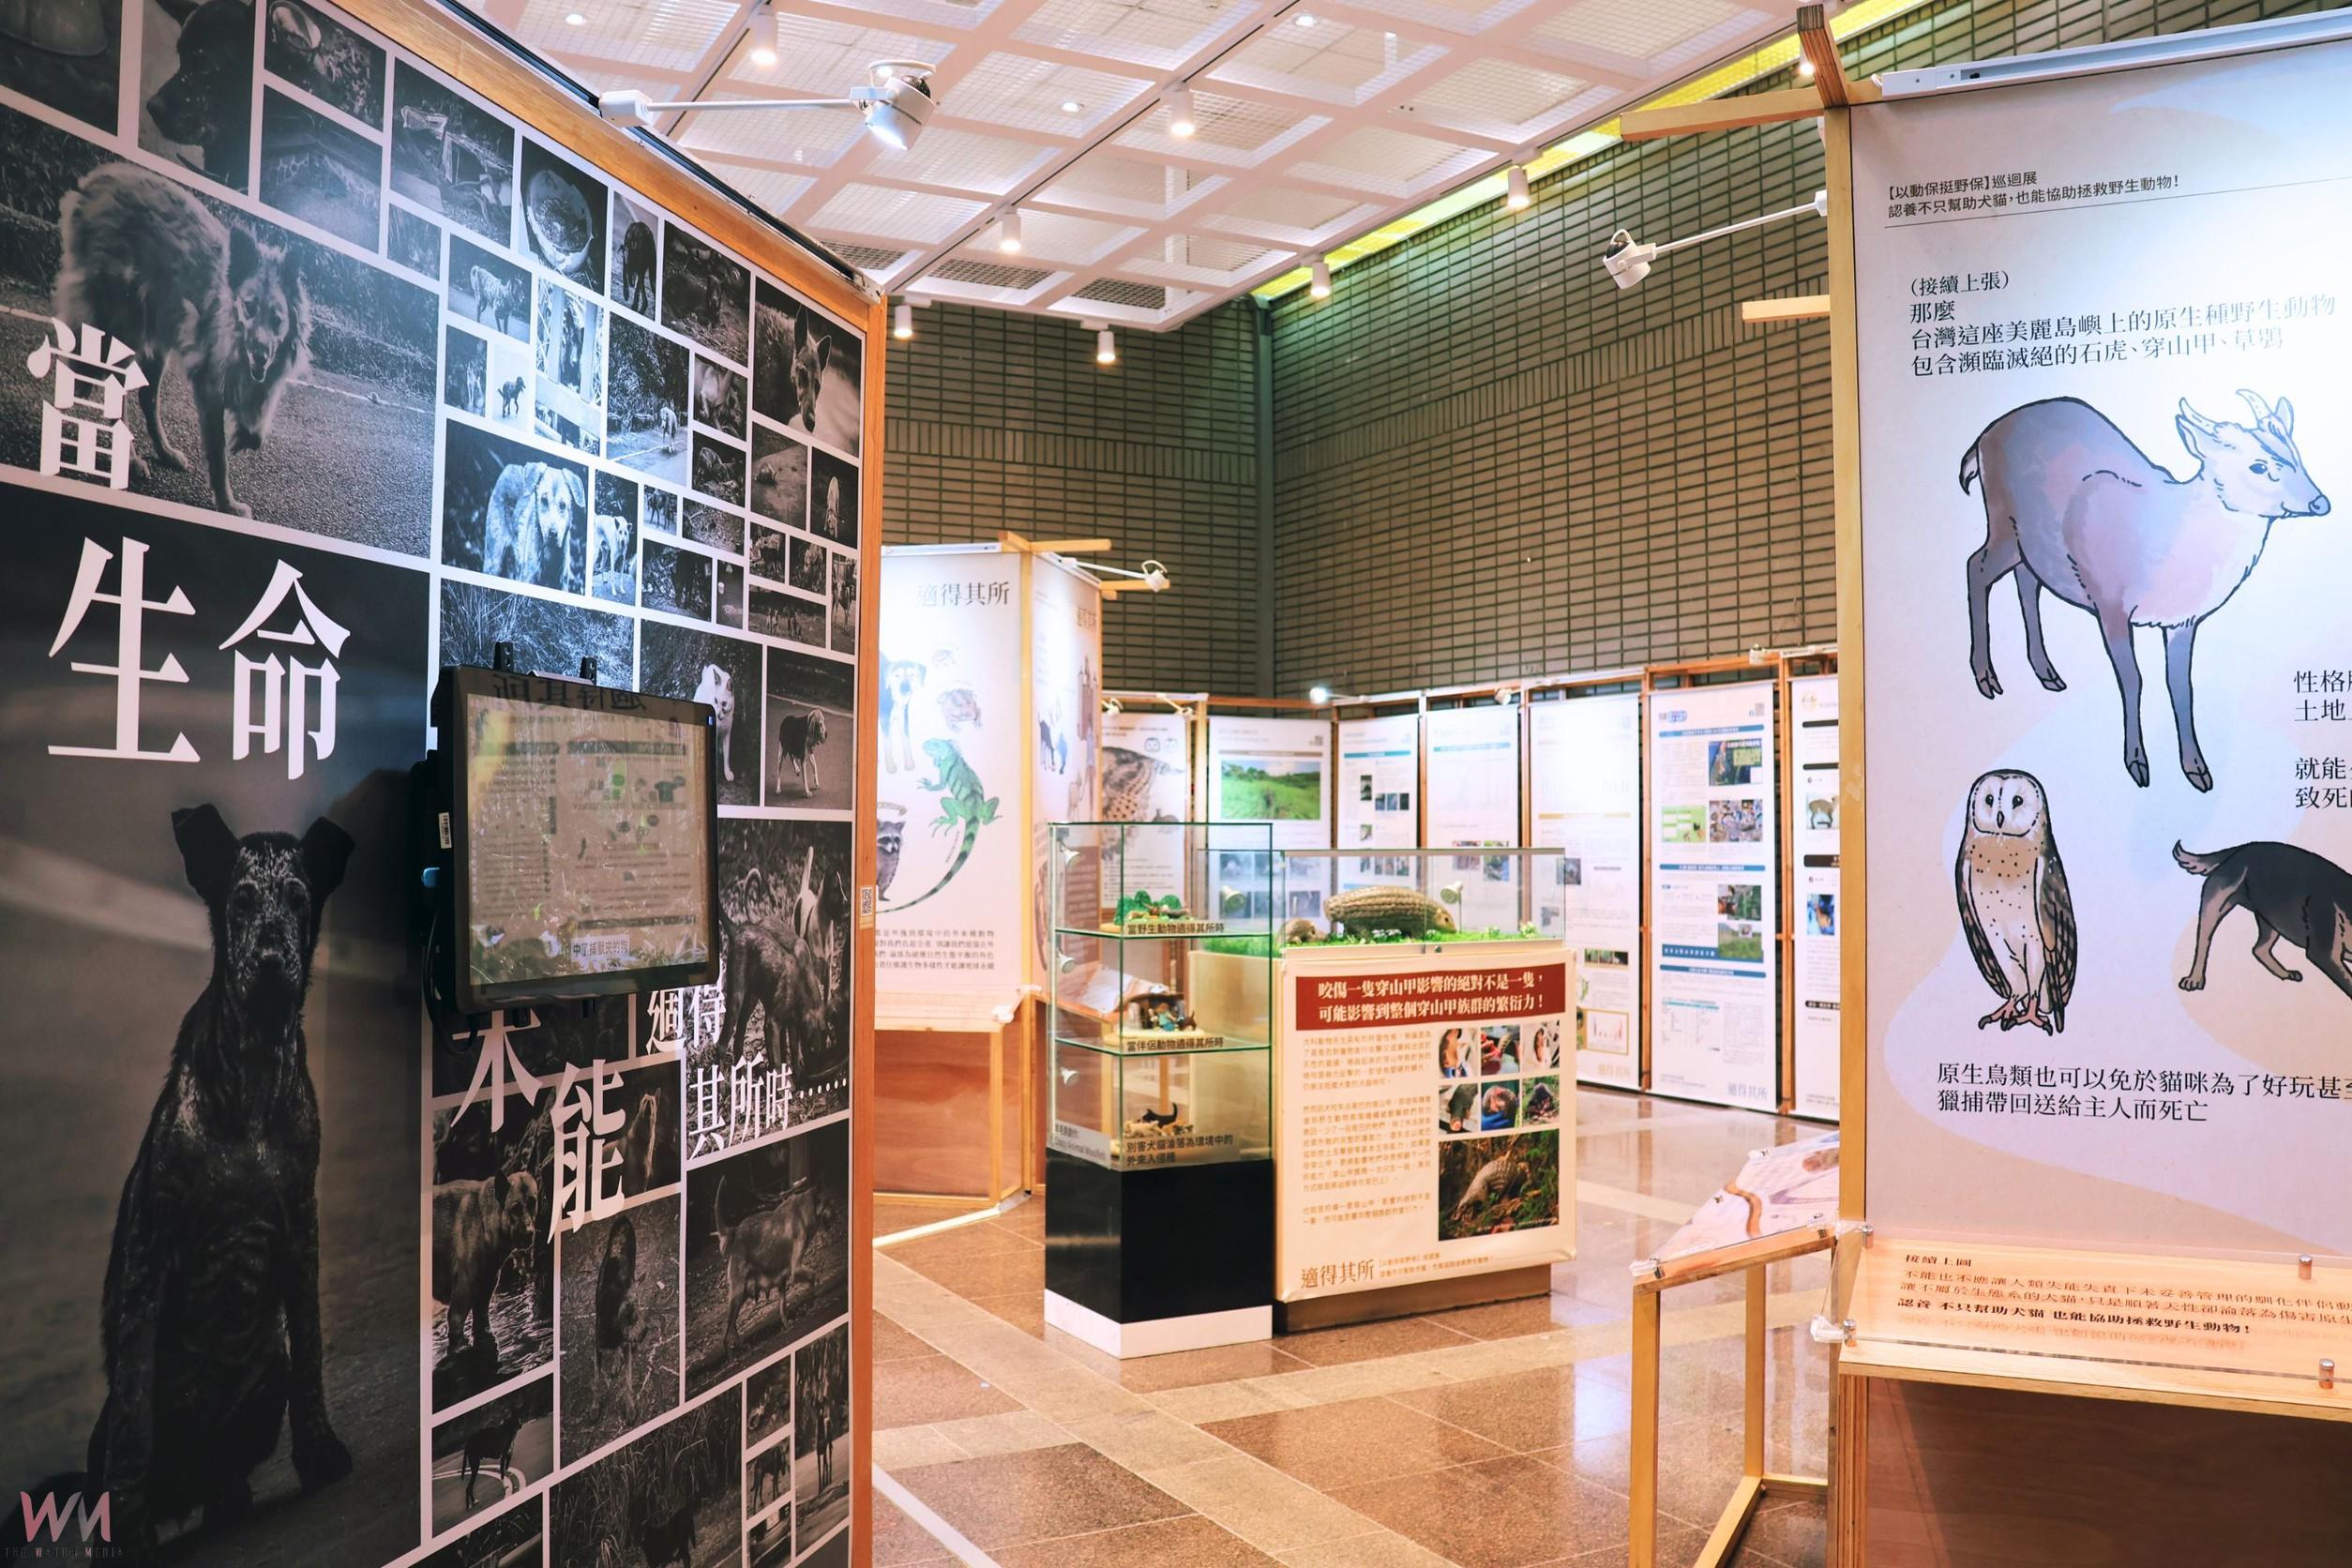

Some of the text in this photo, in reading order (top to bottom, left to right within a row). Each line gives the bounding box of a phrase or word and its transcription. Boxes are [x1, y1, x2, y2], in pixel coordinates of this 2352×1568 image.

[1888, 171, 2038, 202] 【以動保挺野保】巡迴展
[1910, 270, 2012, 297] （接續上張）
[1908, 301, 1956, 324] 那麼
[27, 317, 149, 490] 當
[916, 580, 1010, 607] 適得其所
[48, 536, 351, 780] 生命
[2294, 670, 2352, 694] 性格
[2294, 699, 2352, 722] 土地
[2295, 757, 2352, 780] 就能
[2295, 787, 2352, 809] 致死
[1937, 1091, 2208, 1123] 獵捕帶回送給主人而死亡
[1301, 1259, 1374, 1289] 適得其所
